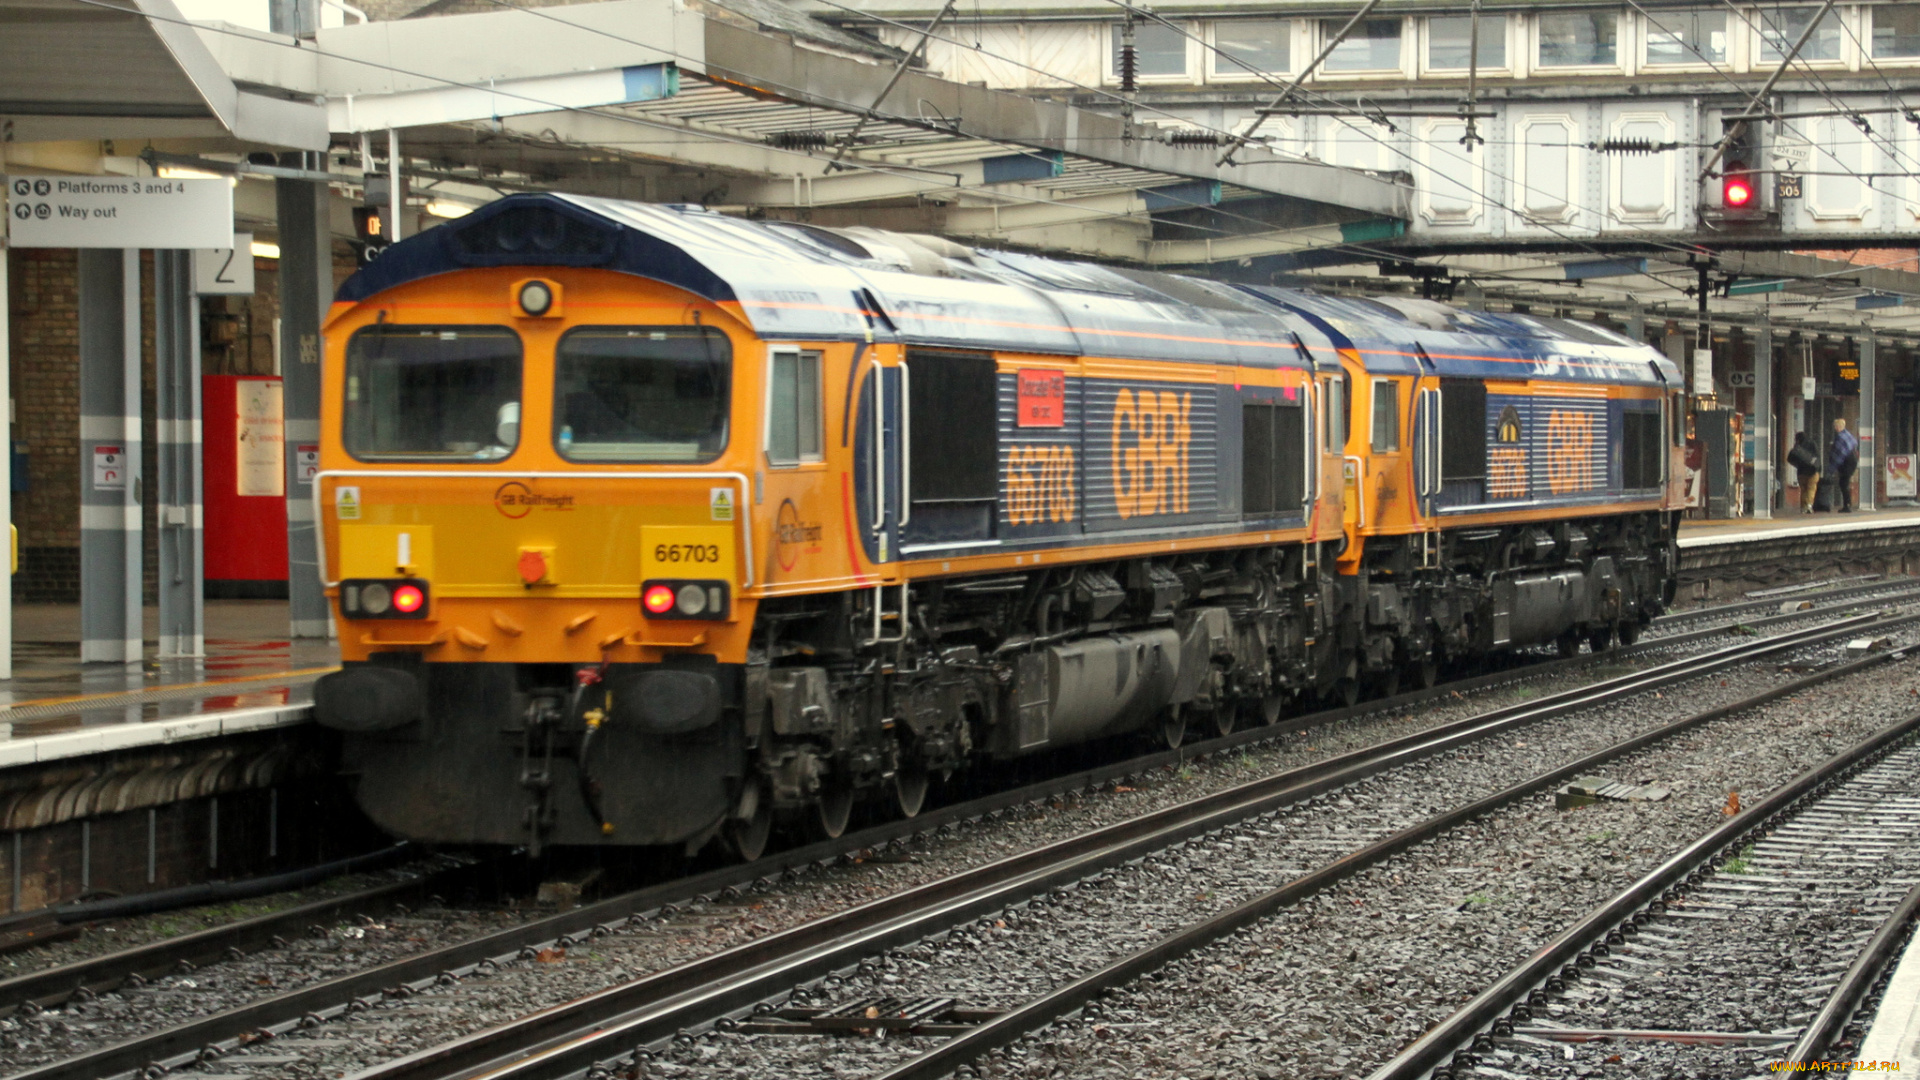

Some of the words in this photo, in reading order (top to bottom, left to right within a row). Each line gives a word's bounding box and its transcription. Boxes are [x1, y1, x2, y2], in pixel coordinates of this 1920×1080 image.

[58, 181, 128, 194] Platforms
[132, 183, 141, 194] 3
[145, 182, 172, 194] and
[176, 183, 185, 194] 4
[58, 205, 89, 220] Way
[93, 206, 117, 218] out
[214, 249, 235, 283] 2
[1007, 445, 1075, 527] 66703
[655, 544, 719, 563] 66703
